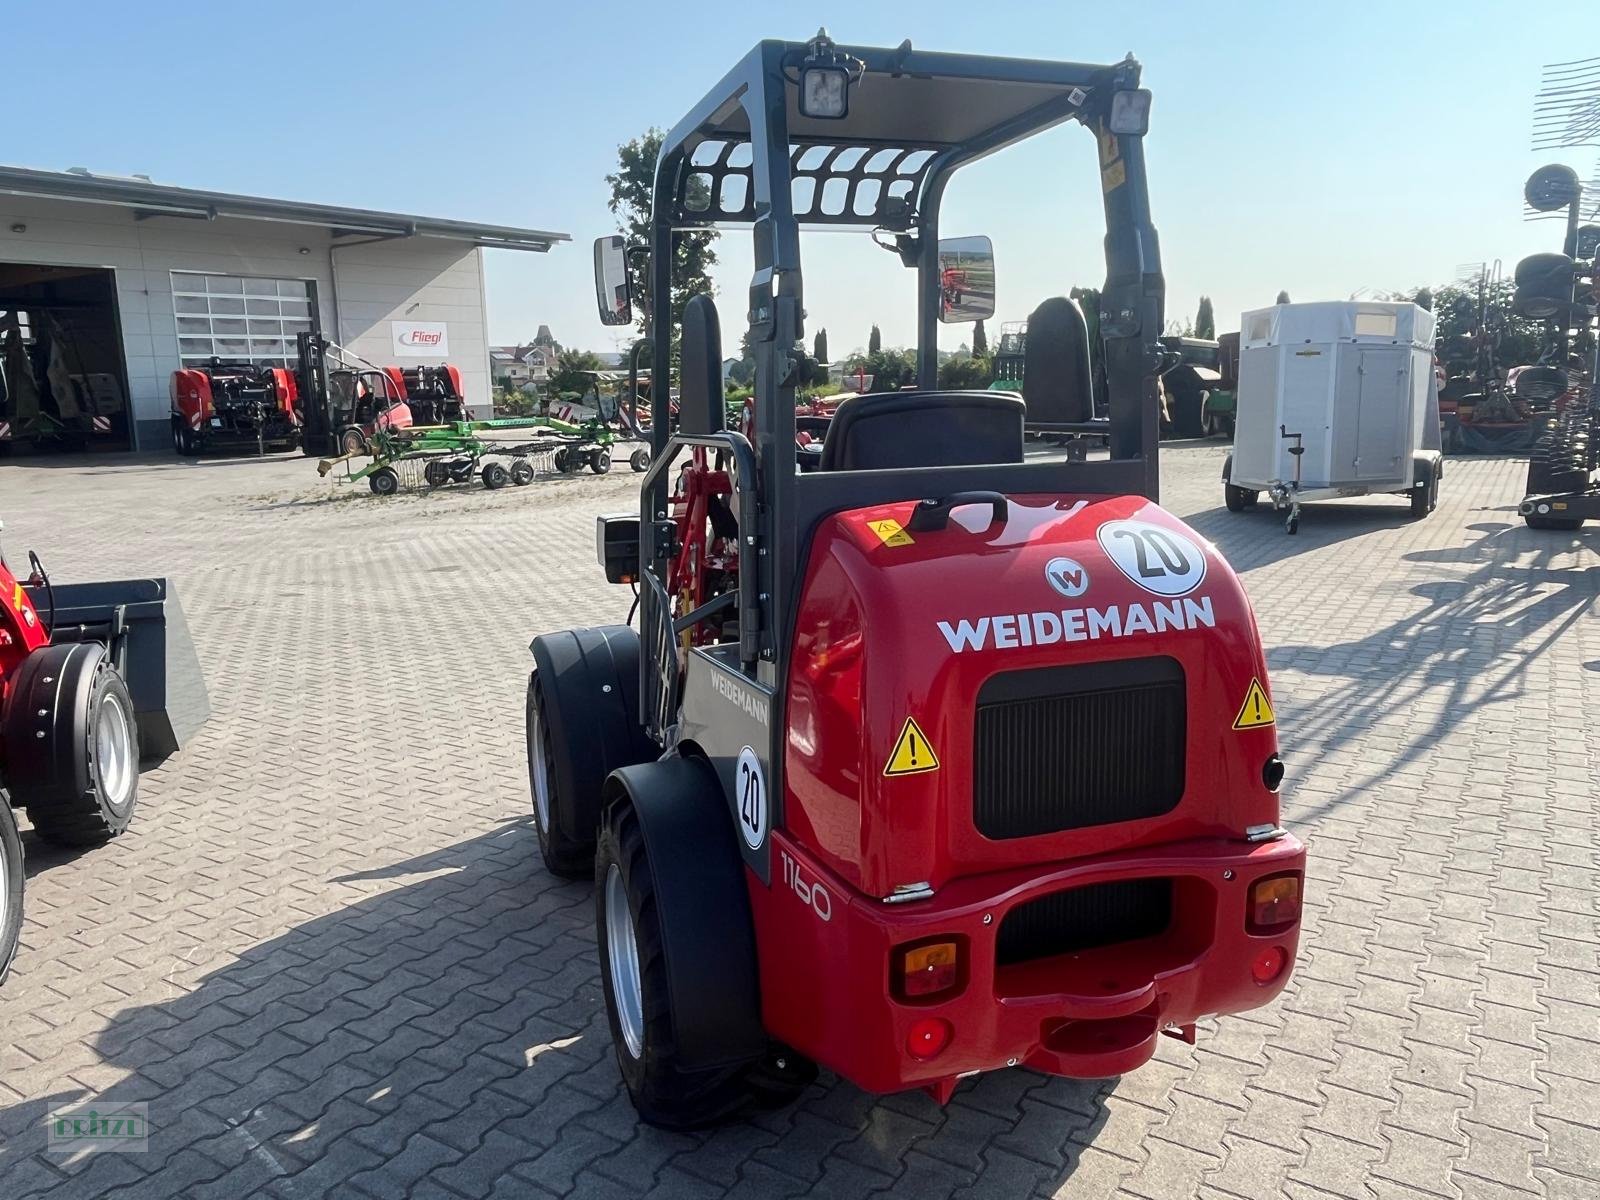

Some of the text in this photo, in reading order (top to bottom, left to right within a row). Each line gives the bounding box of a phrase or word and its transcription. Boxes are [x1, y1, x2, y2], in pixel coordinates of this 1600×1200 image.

[412, 331, 442, 345] Fliegl
[1113, 529, 1191, 578] 20
[937, 597, 1216, 653] WEIDEMANN
[711, 668, 768, 726] WEIDEMANN
[742, 762, 759, 834] 20
[781, 851, 831, 921] 1160
